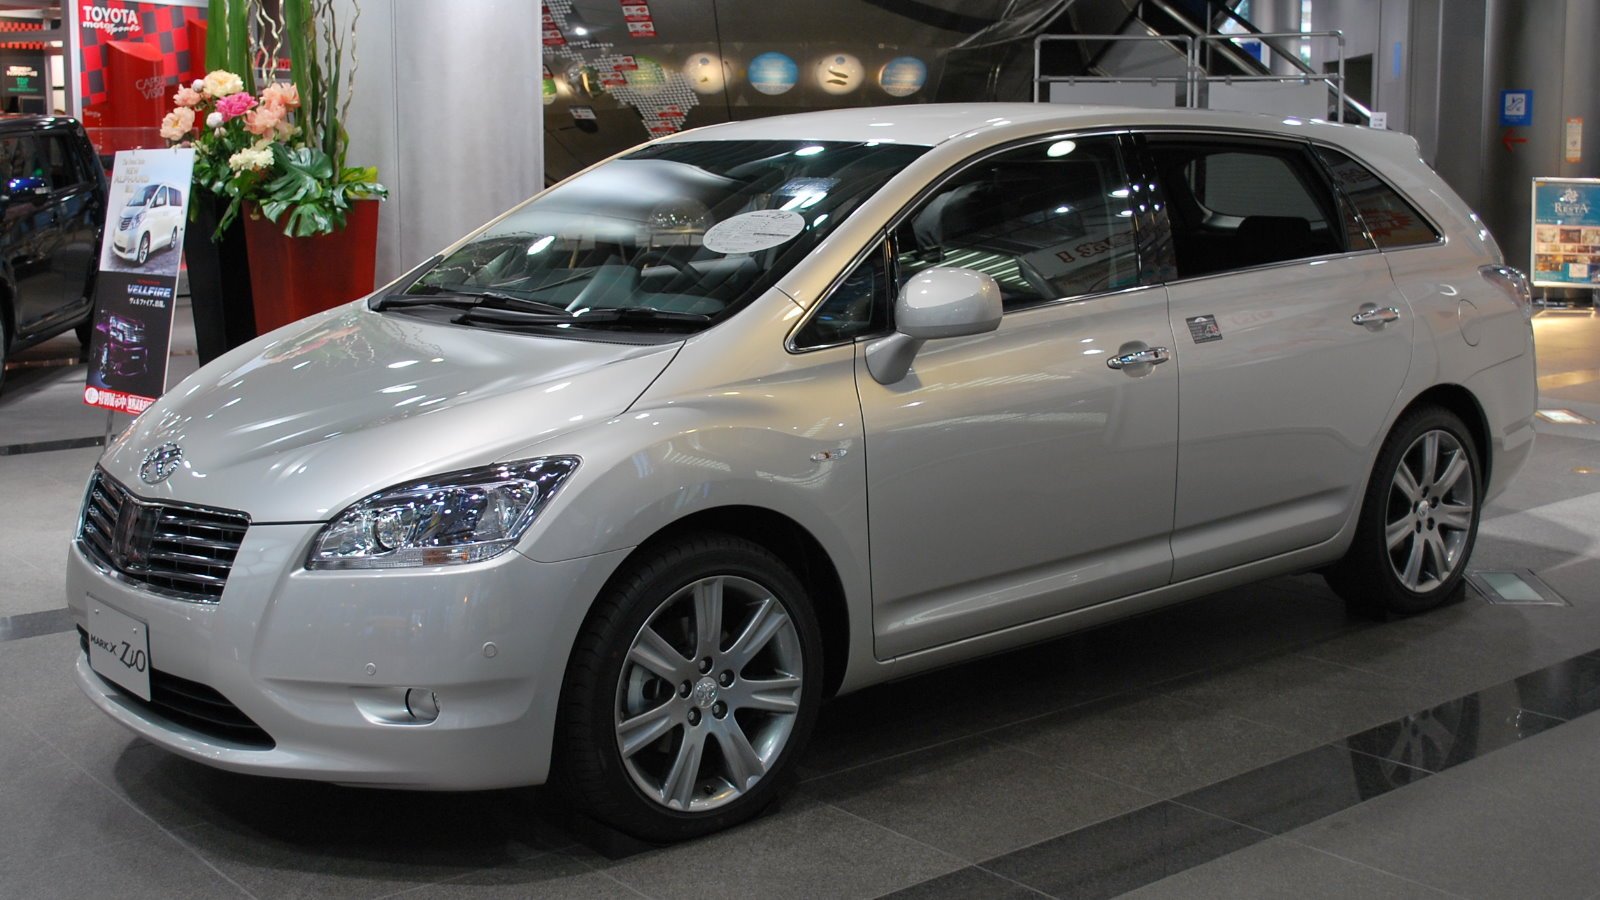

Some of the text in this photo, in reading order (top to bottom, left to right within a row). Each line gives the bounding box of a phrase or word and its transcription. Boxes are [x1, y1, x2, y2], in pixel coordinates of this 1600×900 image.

[83, 5, 138, 25] TOYOTA
[127, 284, 172, 298] VELLFIRE
[109, 642, 117, 656] X
